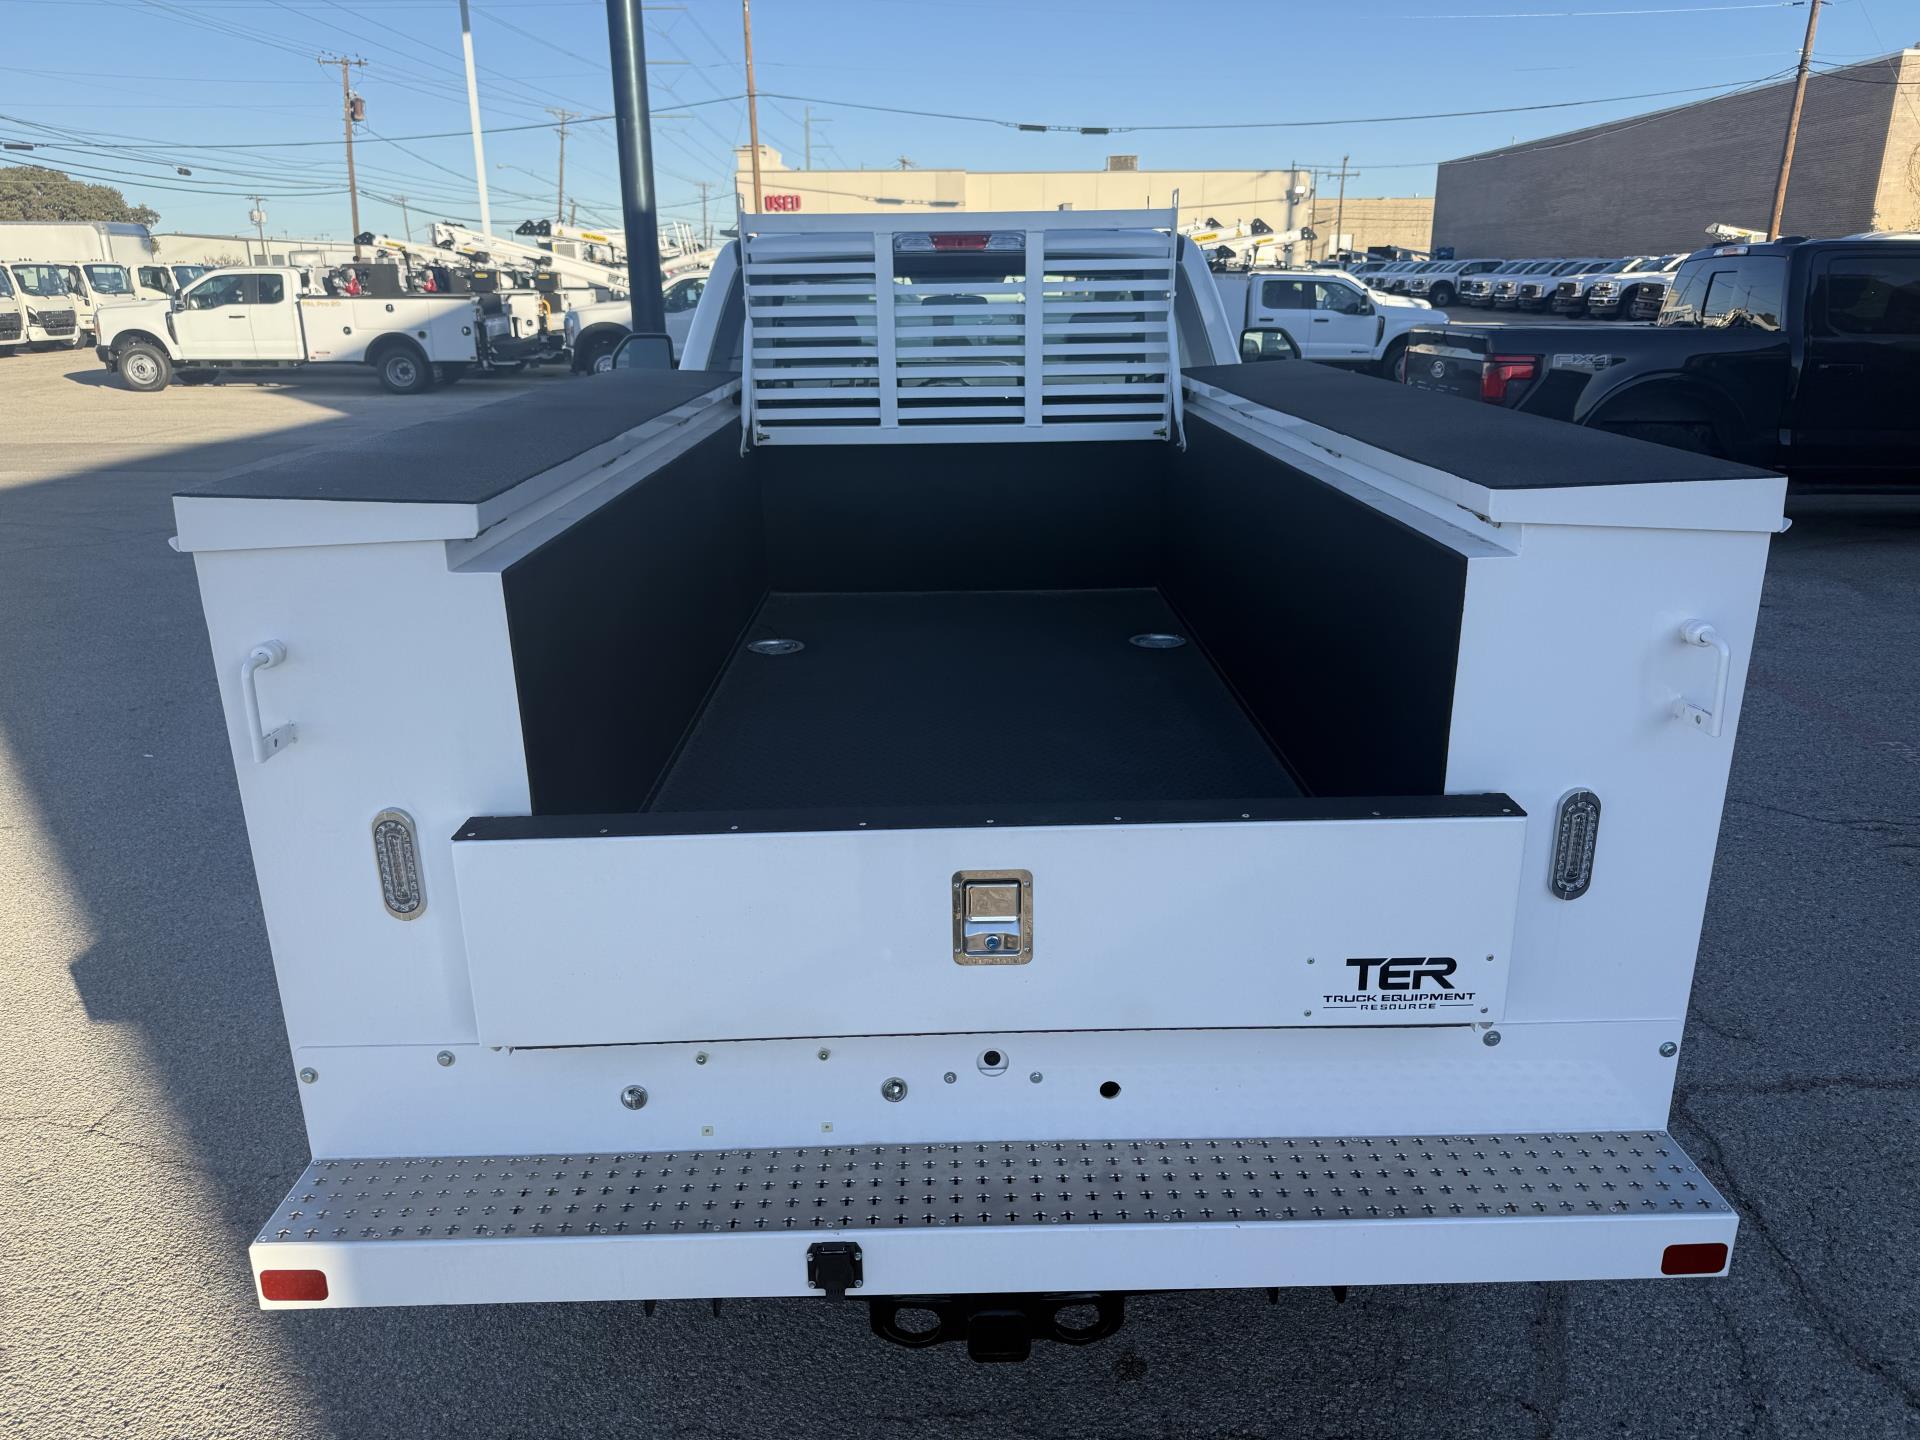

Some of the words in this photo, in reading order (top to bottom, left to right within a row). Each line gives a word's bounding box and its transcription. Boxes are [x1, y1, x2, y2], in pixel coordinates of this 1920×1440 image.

[764, 195, 801, 211] USED
[1552, 354, 1608, 367] FX4
[1345, 957, 1458, 991] TER
[1322, 994, 1378, 1003] TRUCK
[1380, 992, 1477, 1003] EQUIPMENT
[1360, 1003, 1437, 1011] RESOURCE
